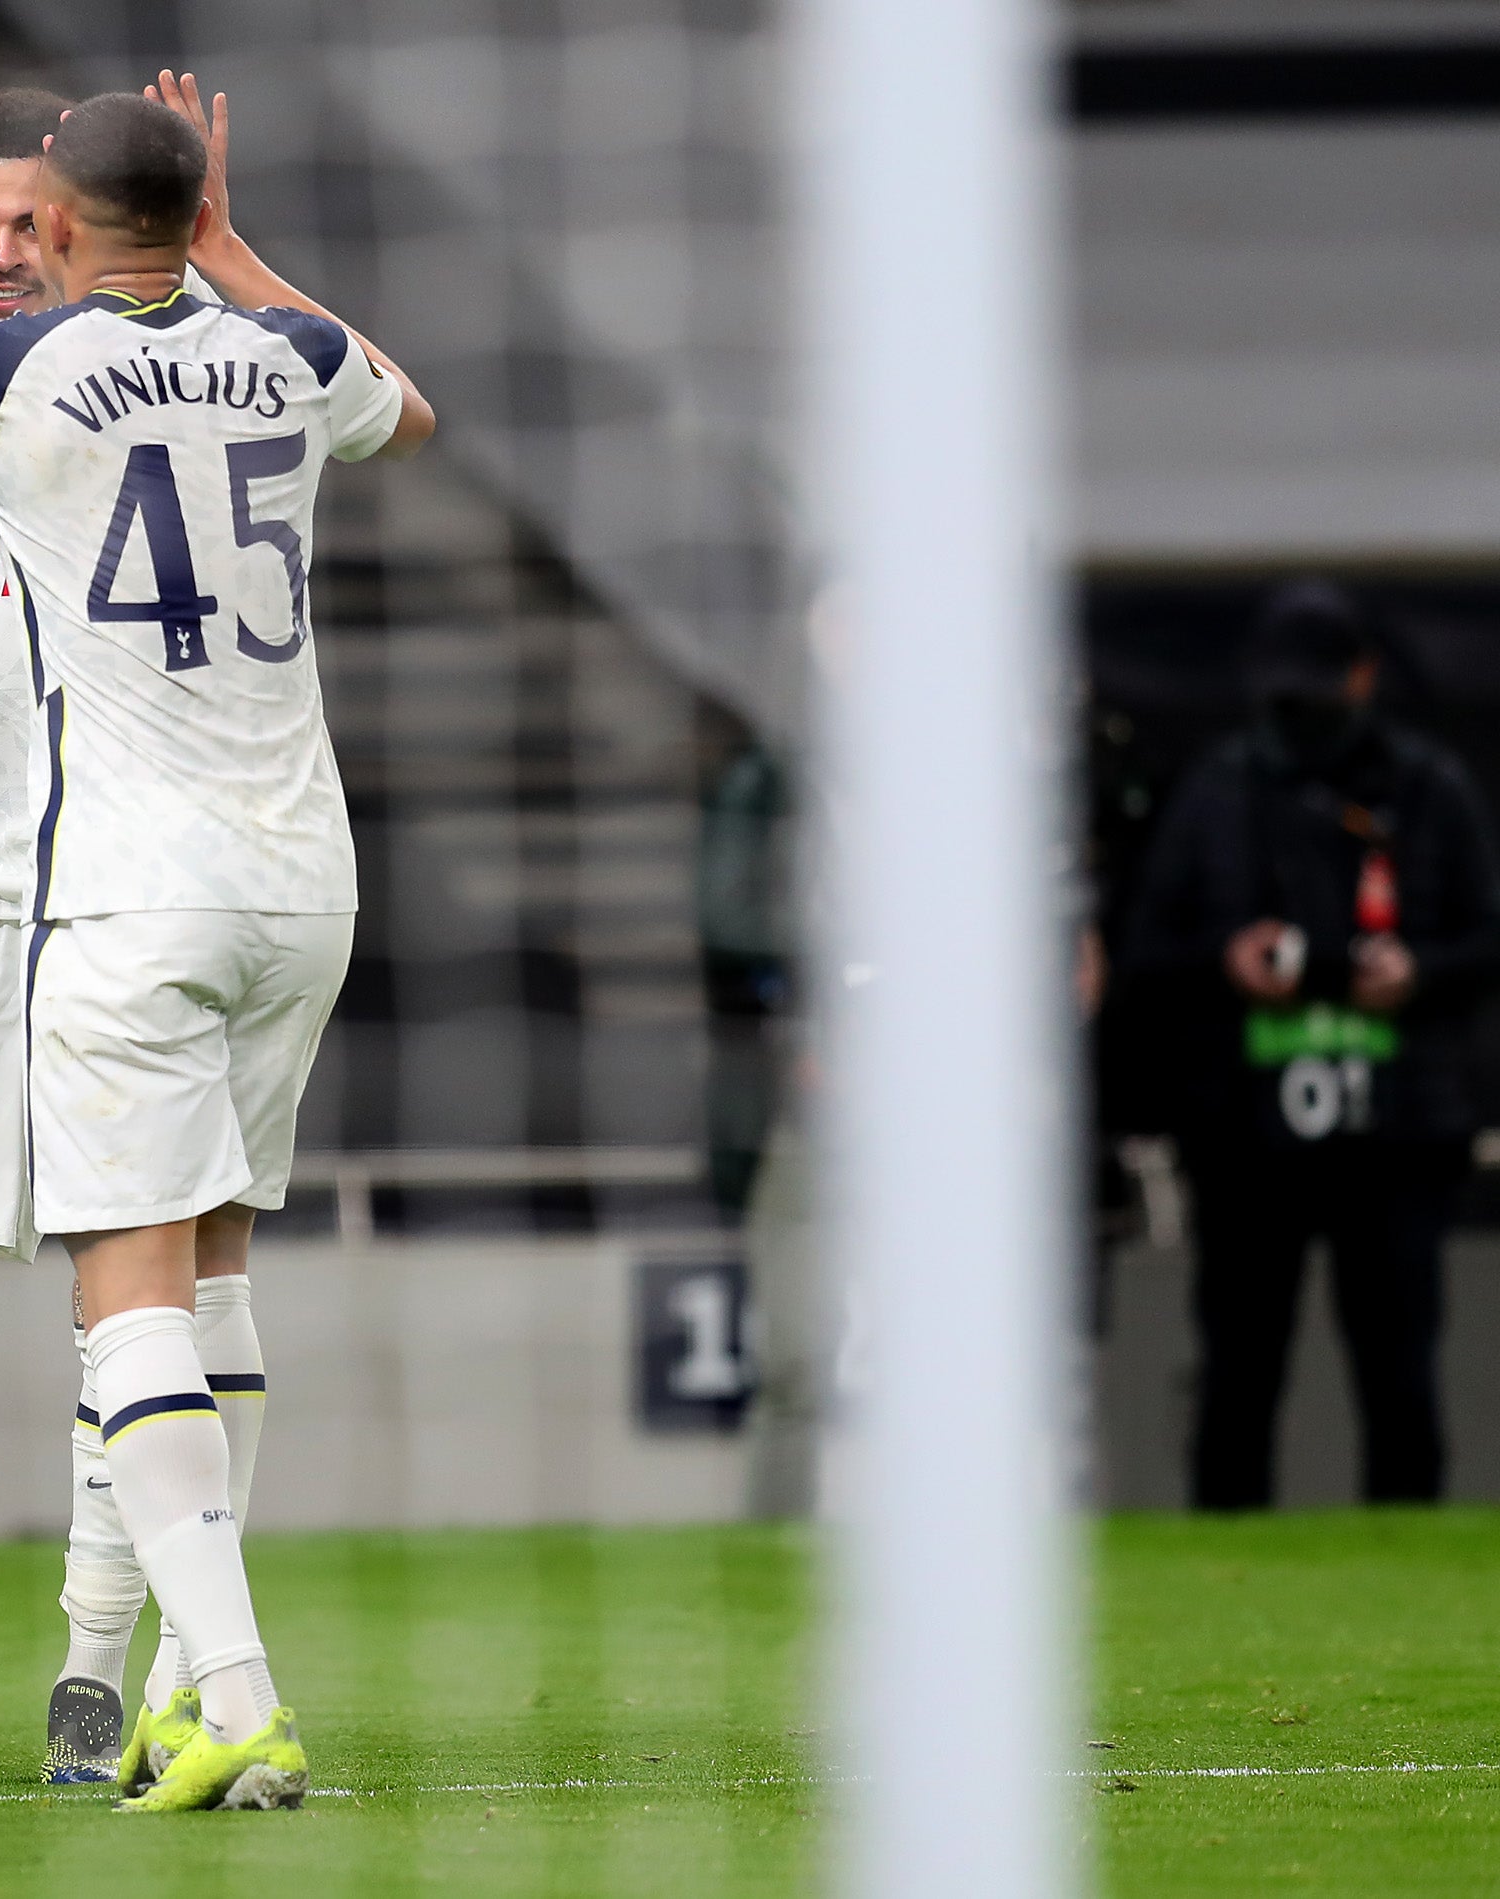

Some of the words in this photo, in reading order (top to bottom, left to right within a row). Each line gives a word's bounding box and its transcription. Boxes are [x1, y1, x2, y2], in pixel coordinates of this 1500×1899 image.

[52, 346, 288, 433] VINÍCIUS
[87, 426, 307, 672] 45
[66, 1684, 105, 1701] PREDATOR
